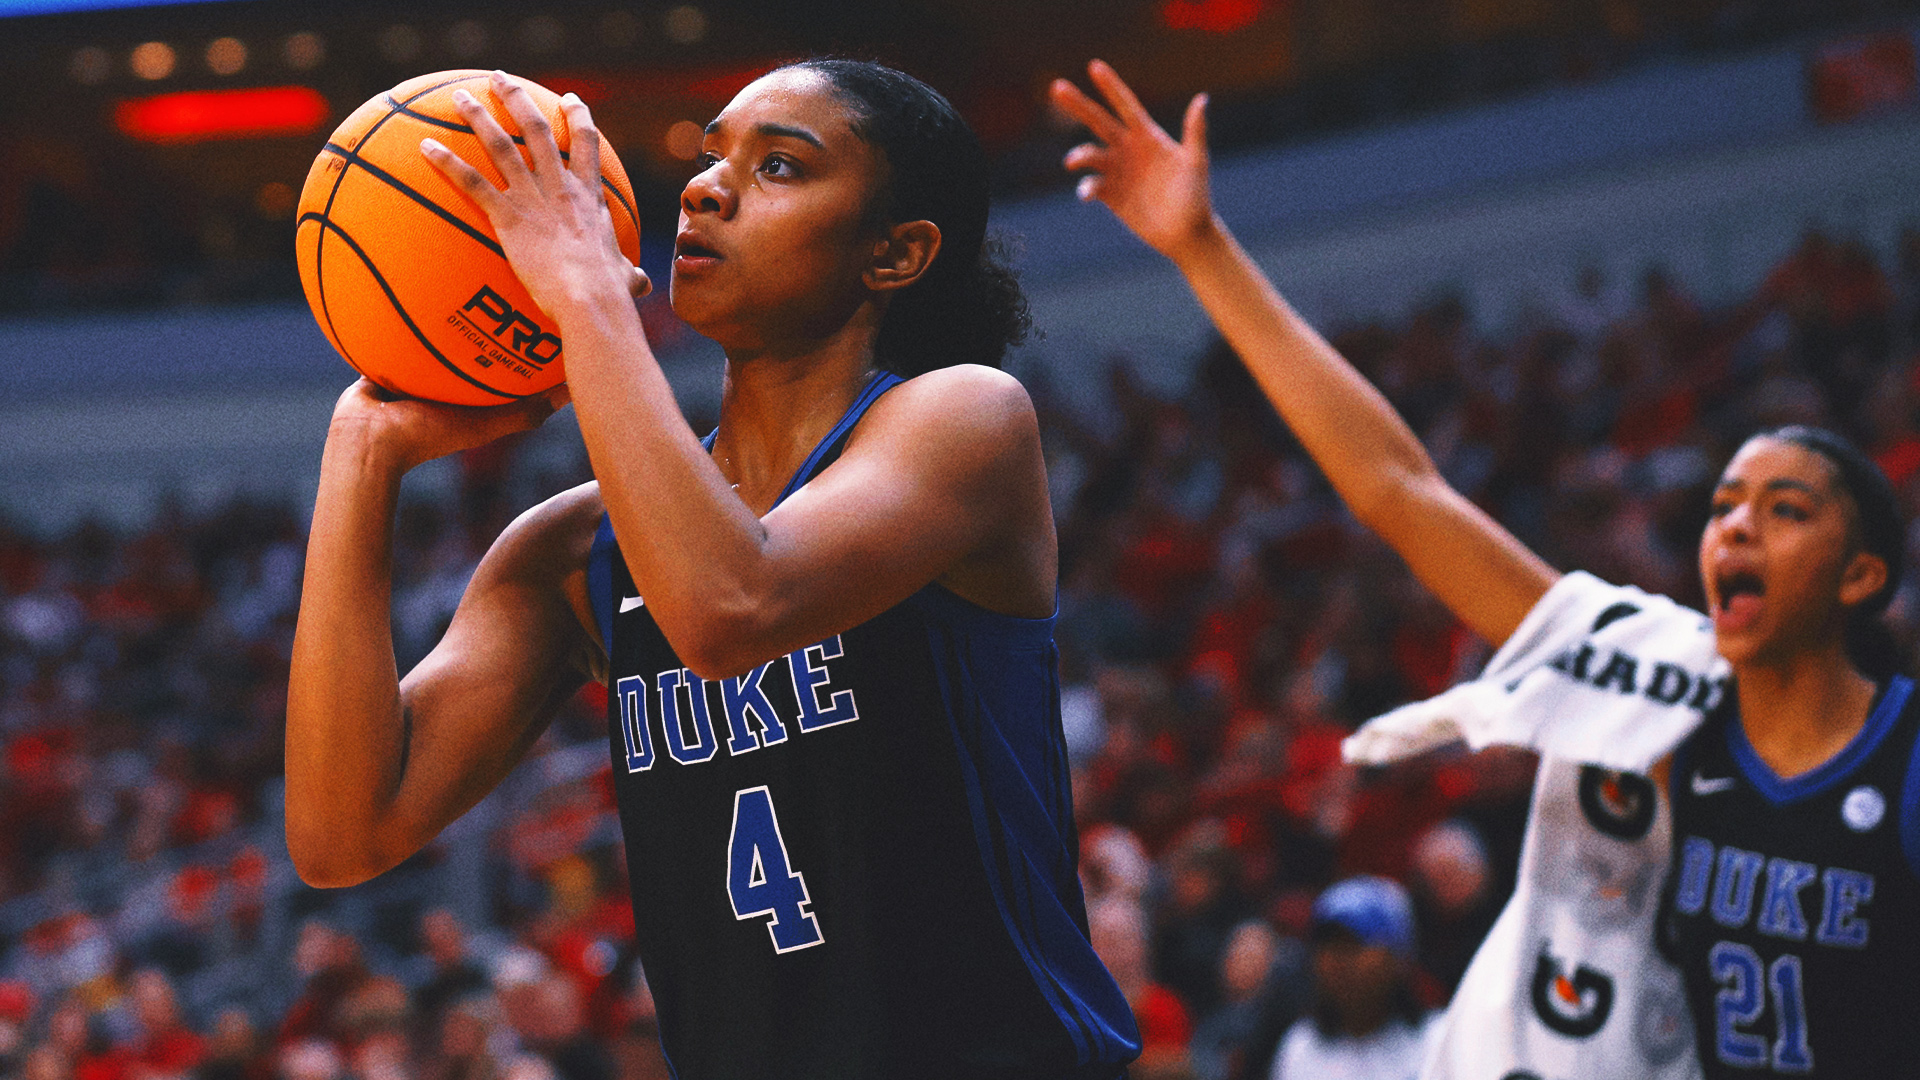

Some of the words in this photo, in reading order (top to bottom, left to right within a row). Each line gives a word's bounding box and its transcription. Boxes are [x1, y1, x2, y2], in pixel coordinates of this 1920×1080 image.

[447, 315, 489, 352] OFFICIAL
[488, 348, 516, 369] GAME
[513, 364, 535, 380] BALL
[462, 284, 563, 365] PRO
[617, 633, 860, 774] DUKE
[726, 785, 826, 955] 4
[1676, 834, 1876, 947] DUKE
[1708, 940, 1815, 1073] 21
